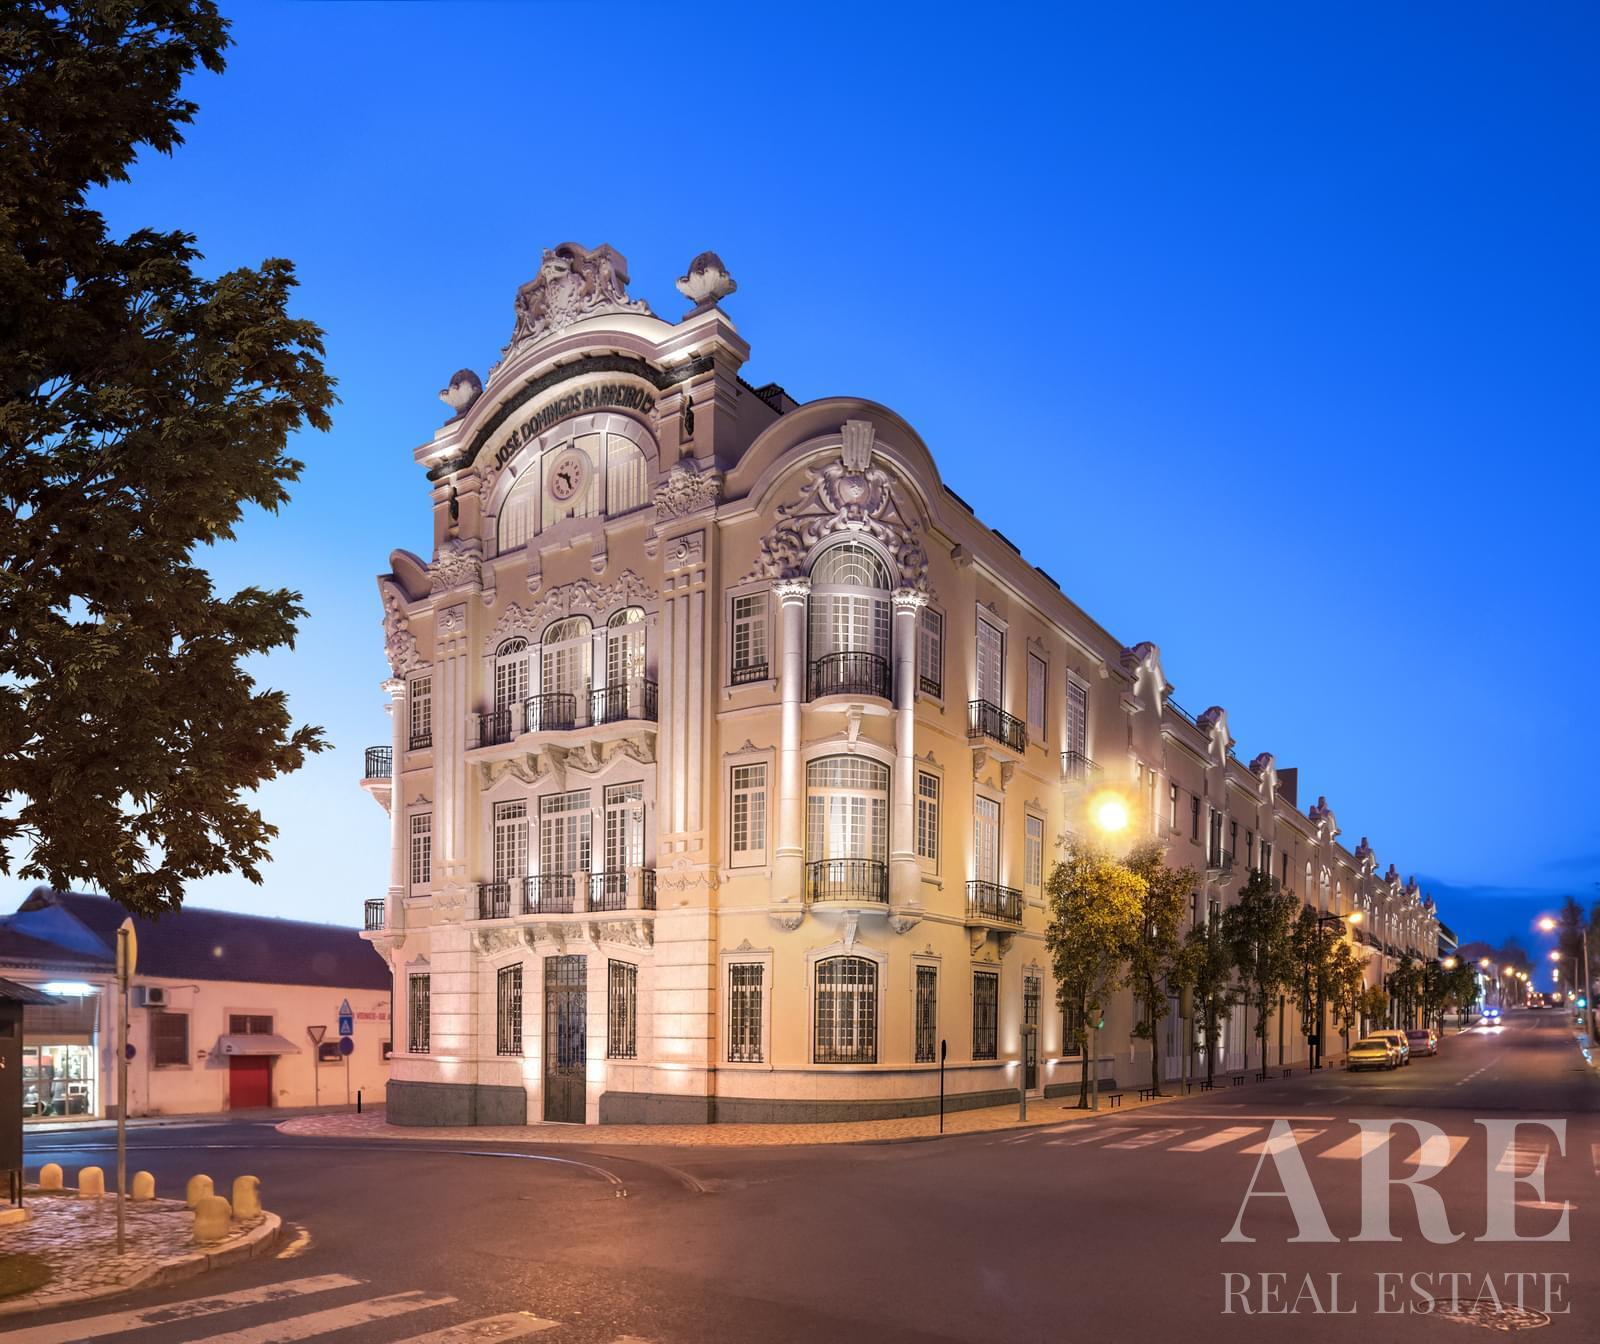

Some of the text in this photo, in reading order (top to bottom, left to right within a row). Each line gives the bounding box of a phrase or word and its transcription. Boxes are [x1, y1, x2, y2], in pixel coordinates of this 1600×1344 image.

[495, 430, 522, 471] JOSÉ
[520, 391, 581, 442] DOMINGOS
[583, 385, 644, 409] BARREIRO
